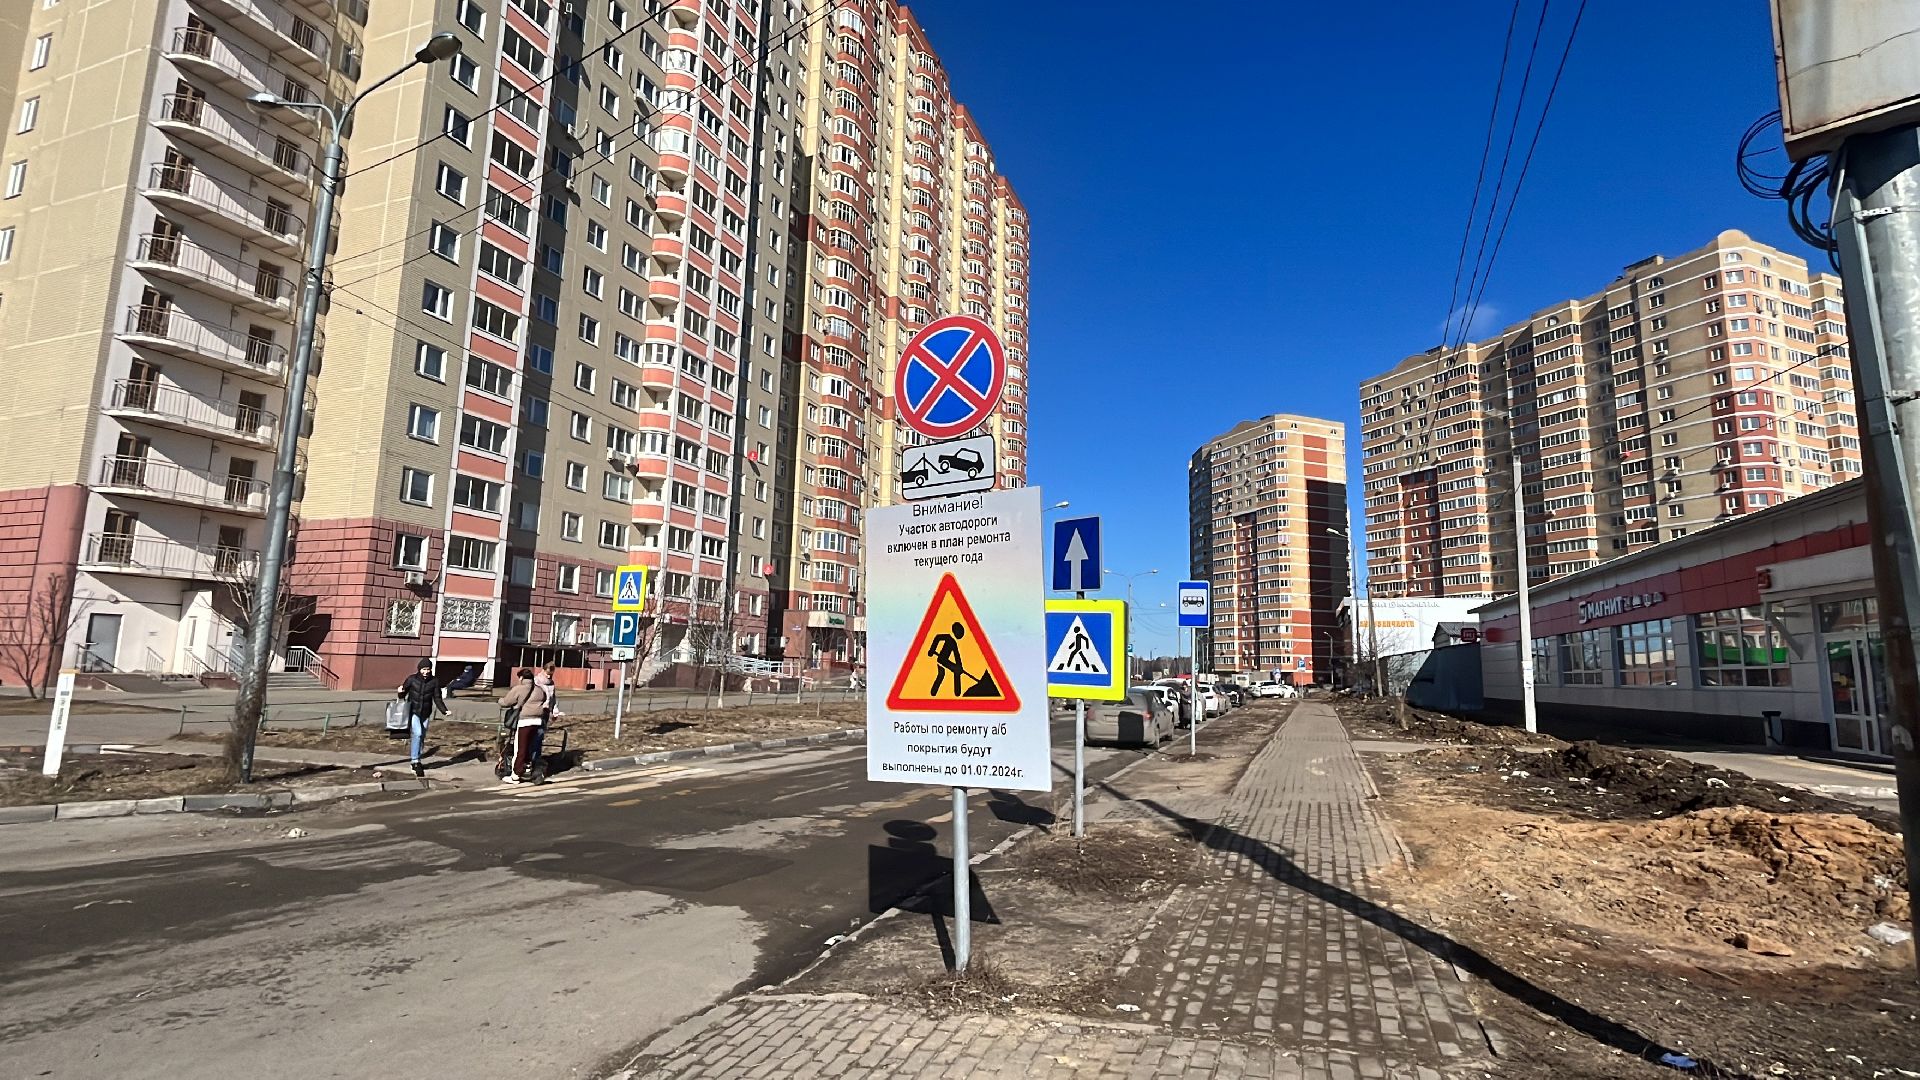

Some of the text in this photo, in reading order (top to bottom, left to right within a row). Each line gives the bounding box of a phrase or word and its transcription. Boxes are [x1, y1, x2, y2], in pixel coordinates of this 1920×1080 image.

[913, 496, 983, 517] Внимание!
[899, 517, 998, 536] Участок автодороги
[887, 532, 1010, 553] включен в план ремонта
[914, 552, 983, 569] текущего года
[1588, 597, 1622, 618] МАГНИТ
[619, 616, 633, 642] P
[894, 722, 1006, 738] Работы по ремонту а/б
[907, 743, 991, 757] покрытия будут
[883, 762, 1023, 777] выполнены до 01.07.2024г.
